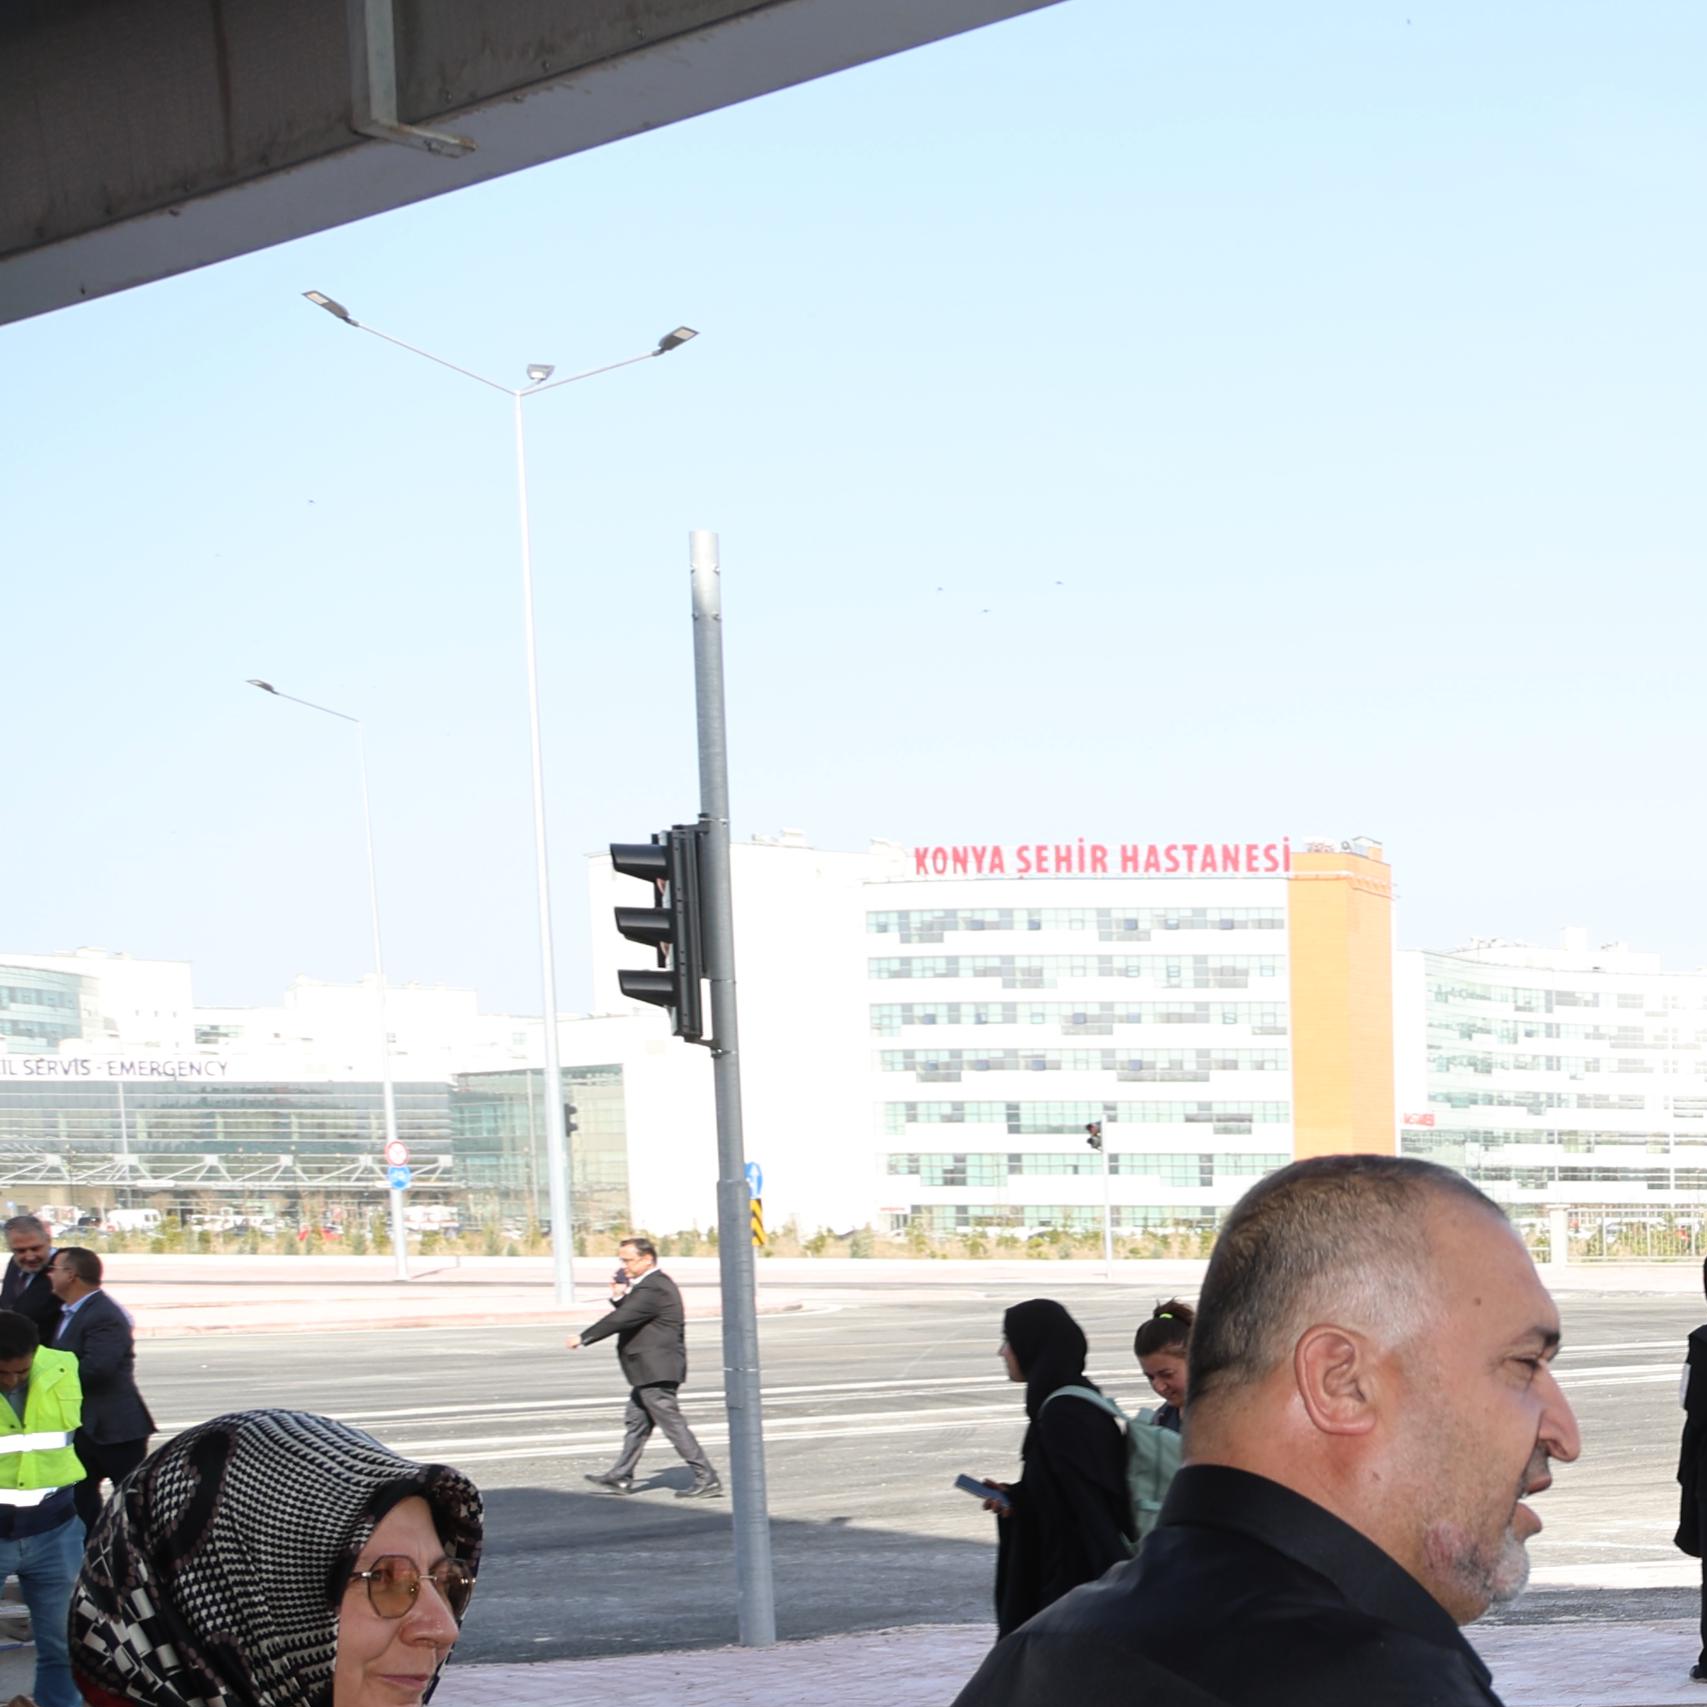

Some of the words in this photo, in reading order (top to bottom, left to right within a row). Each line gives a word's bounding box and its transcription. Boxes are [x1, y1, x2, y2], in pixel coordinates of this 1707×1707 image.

[915, 846, 1005, 875] KONYA
[1120, 837, 1291, 873] HASTANESİ
[107, 1060, 228, 1077] EMERGENCY
